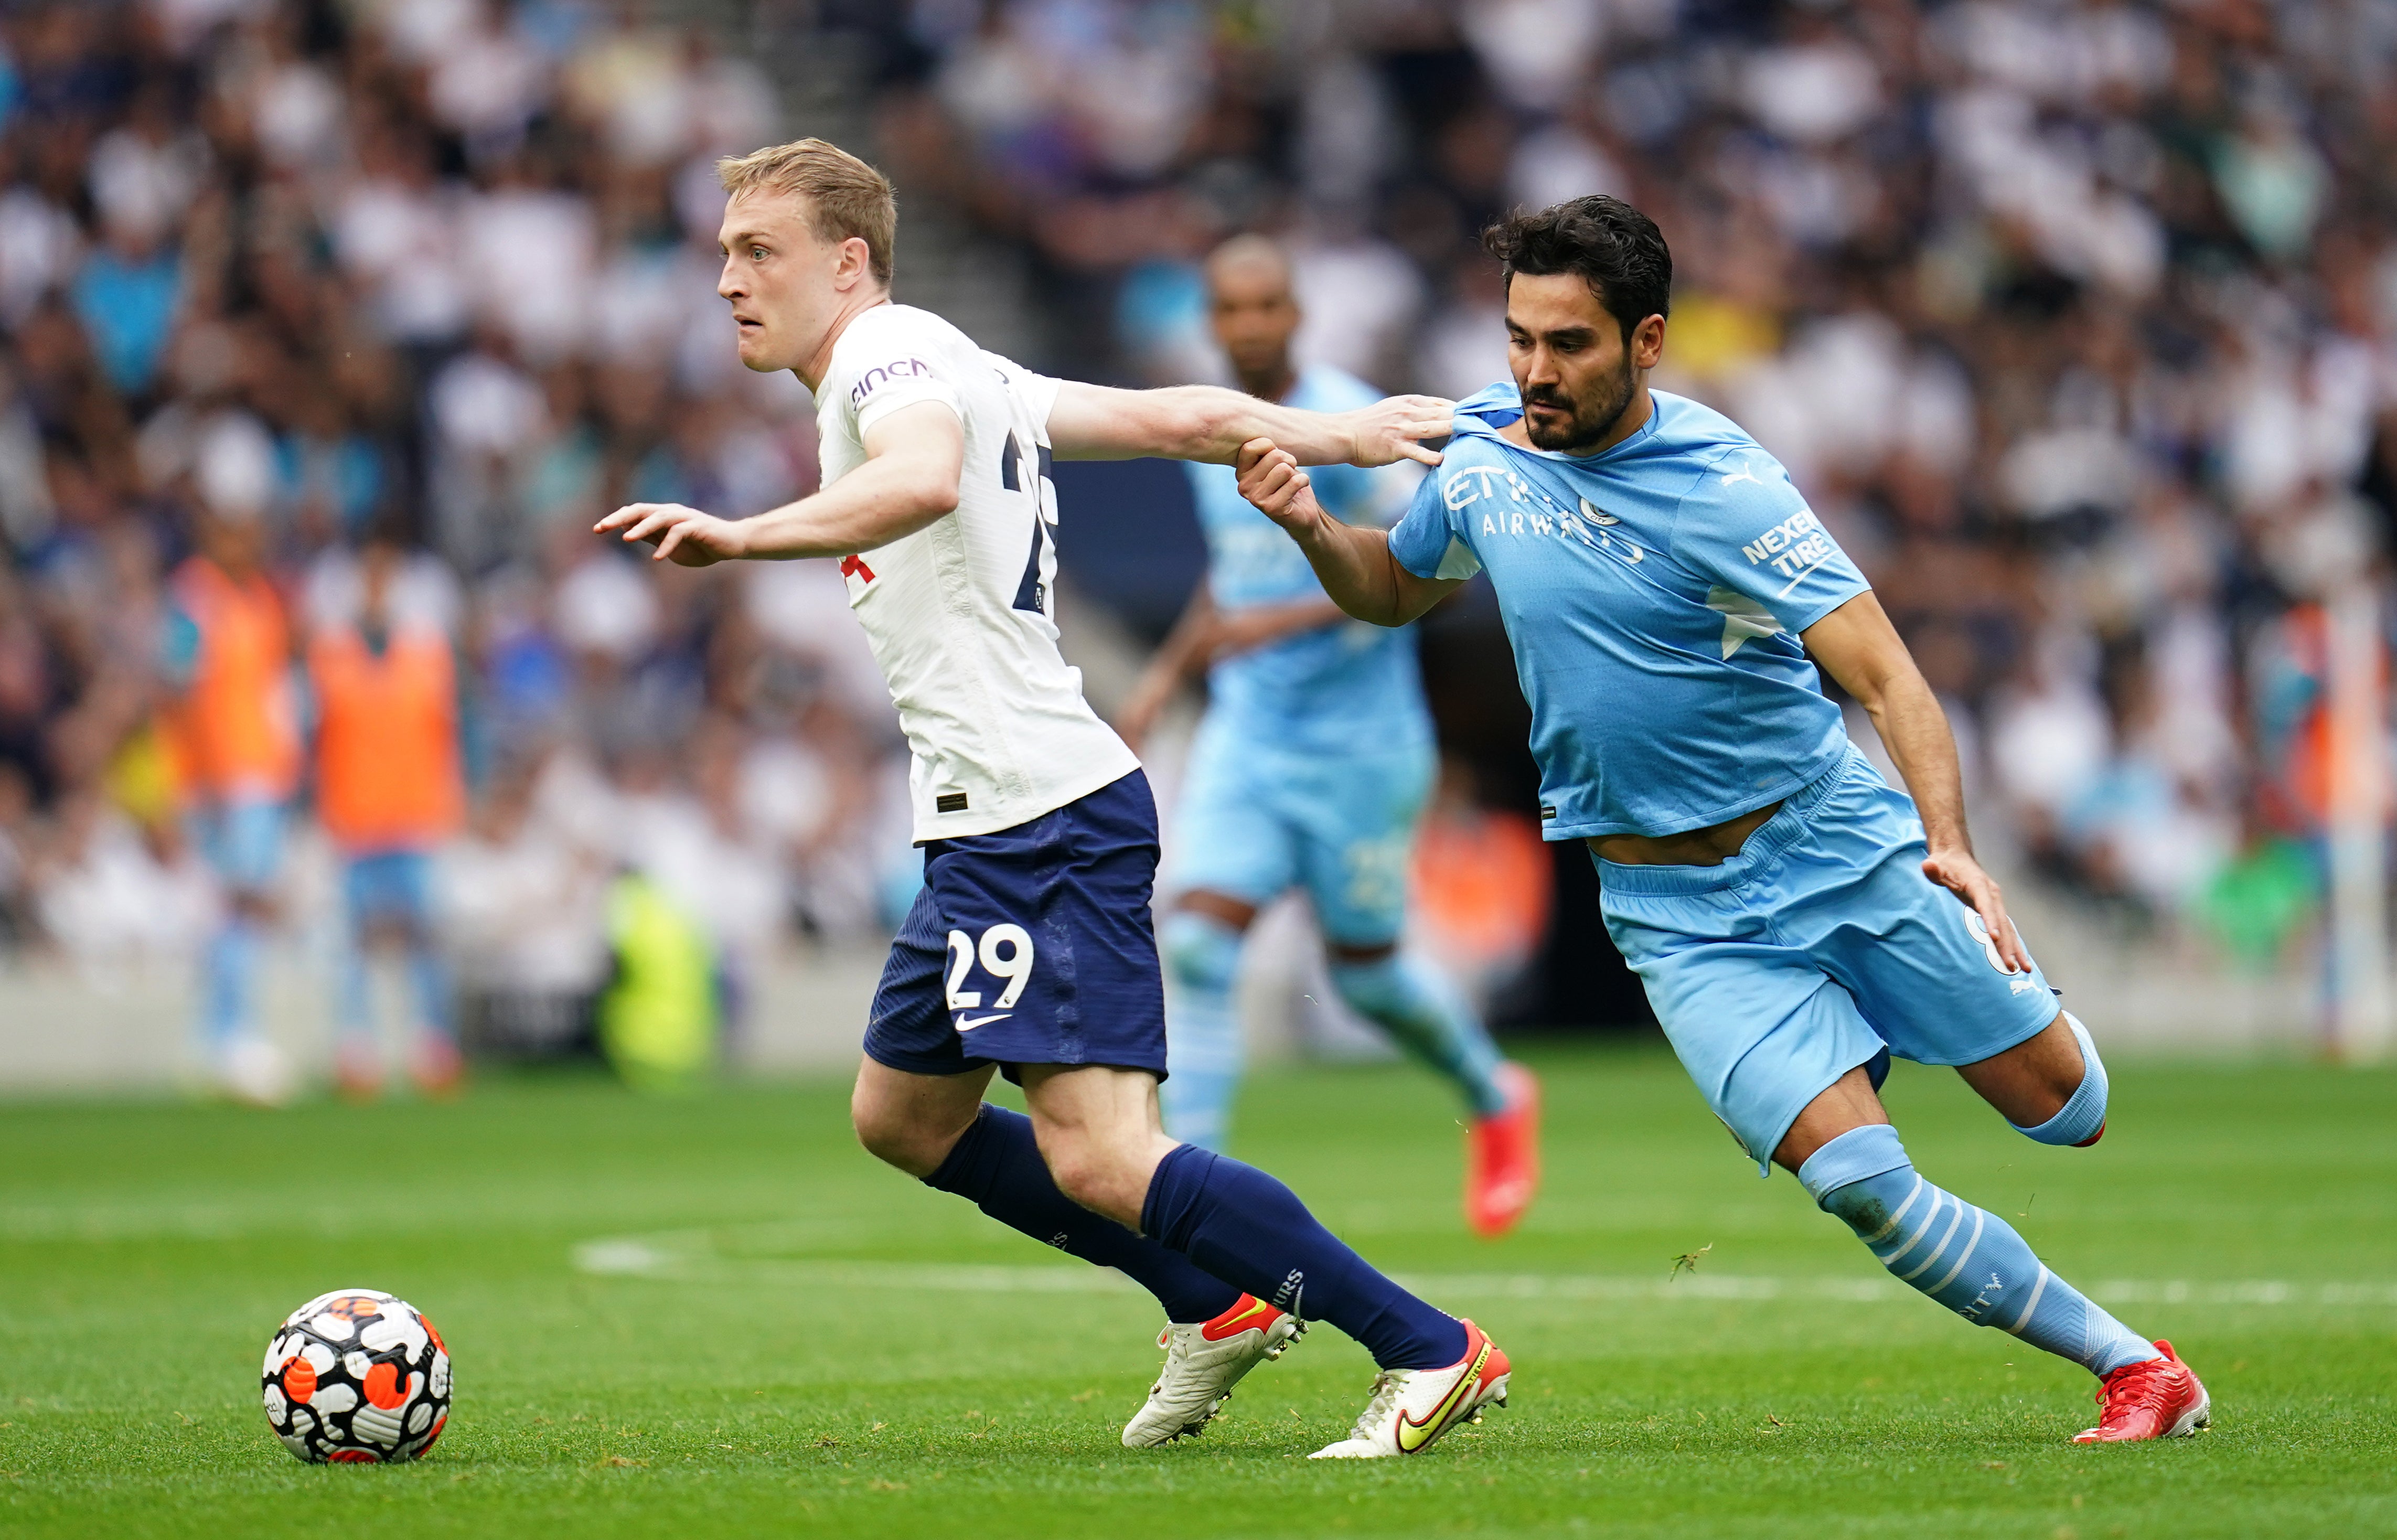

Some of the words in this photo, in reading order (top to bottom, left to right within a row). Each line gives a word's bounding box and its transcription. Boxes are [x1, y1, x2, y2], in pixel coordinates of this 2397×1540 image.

[852, 358, 933, 411] cinch
[1742, 508, 1818, 565] NEXEN
[1771, 532, 1830, 576] TIRE
[946, 923, 1034, 1011] 29
[1963, 905, 2022, 976] 8
